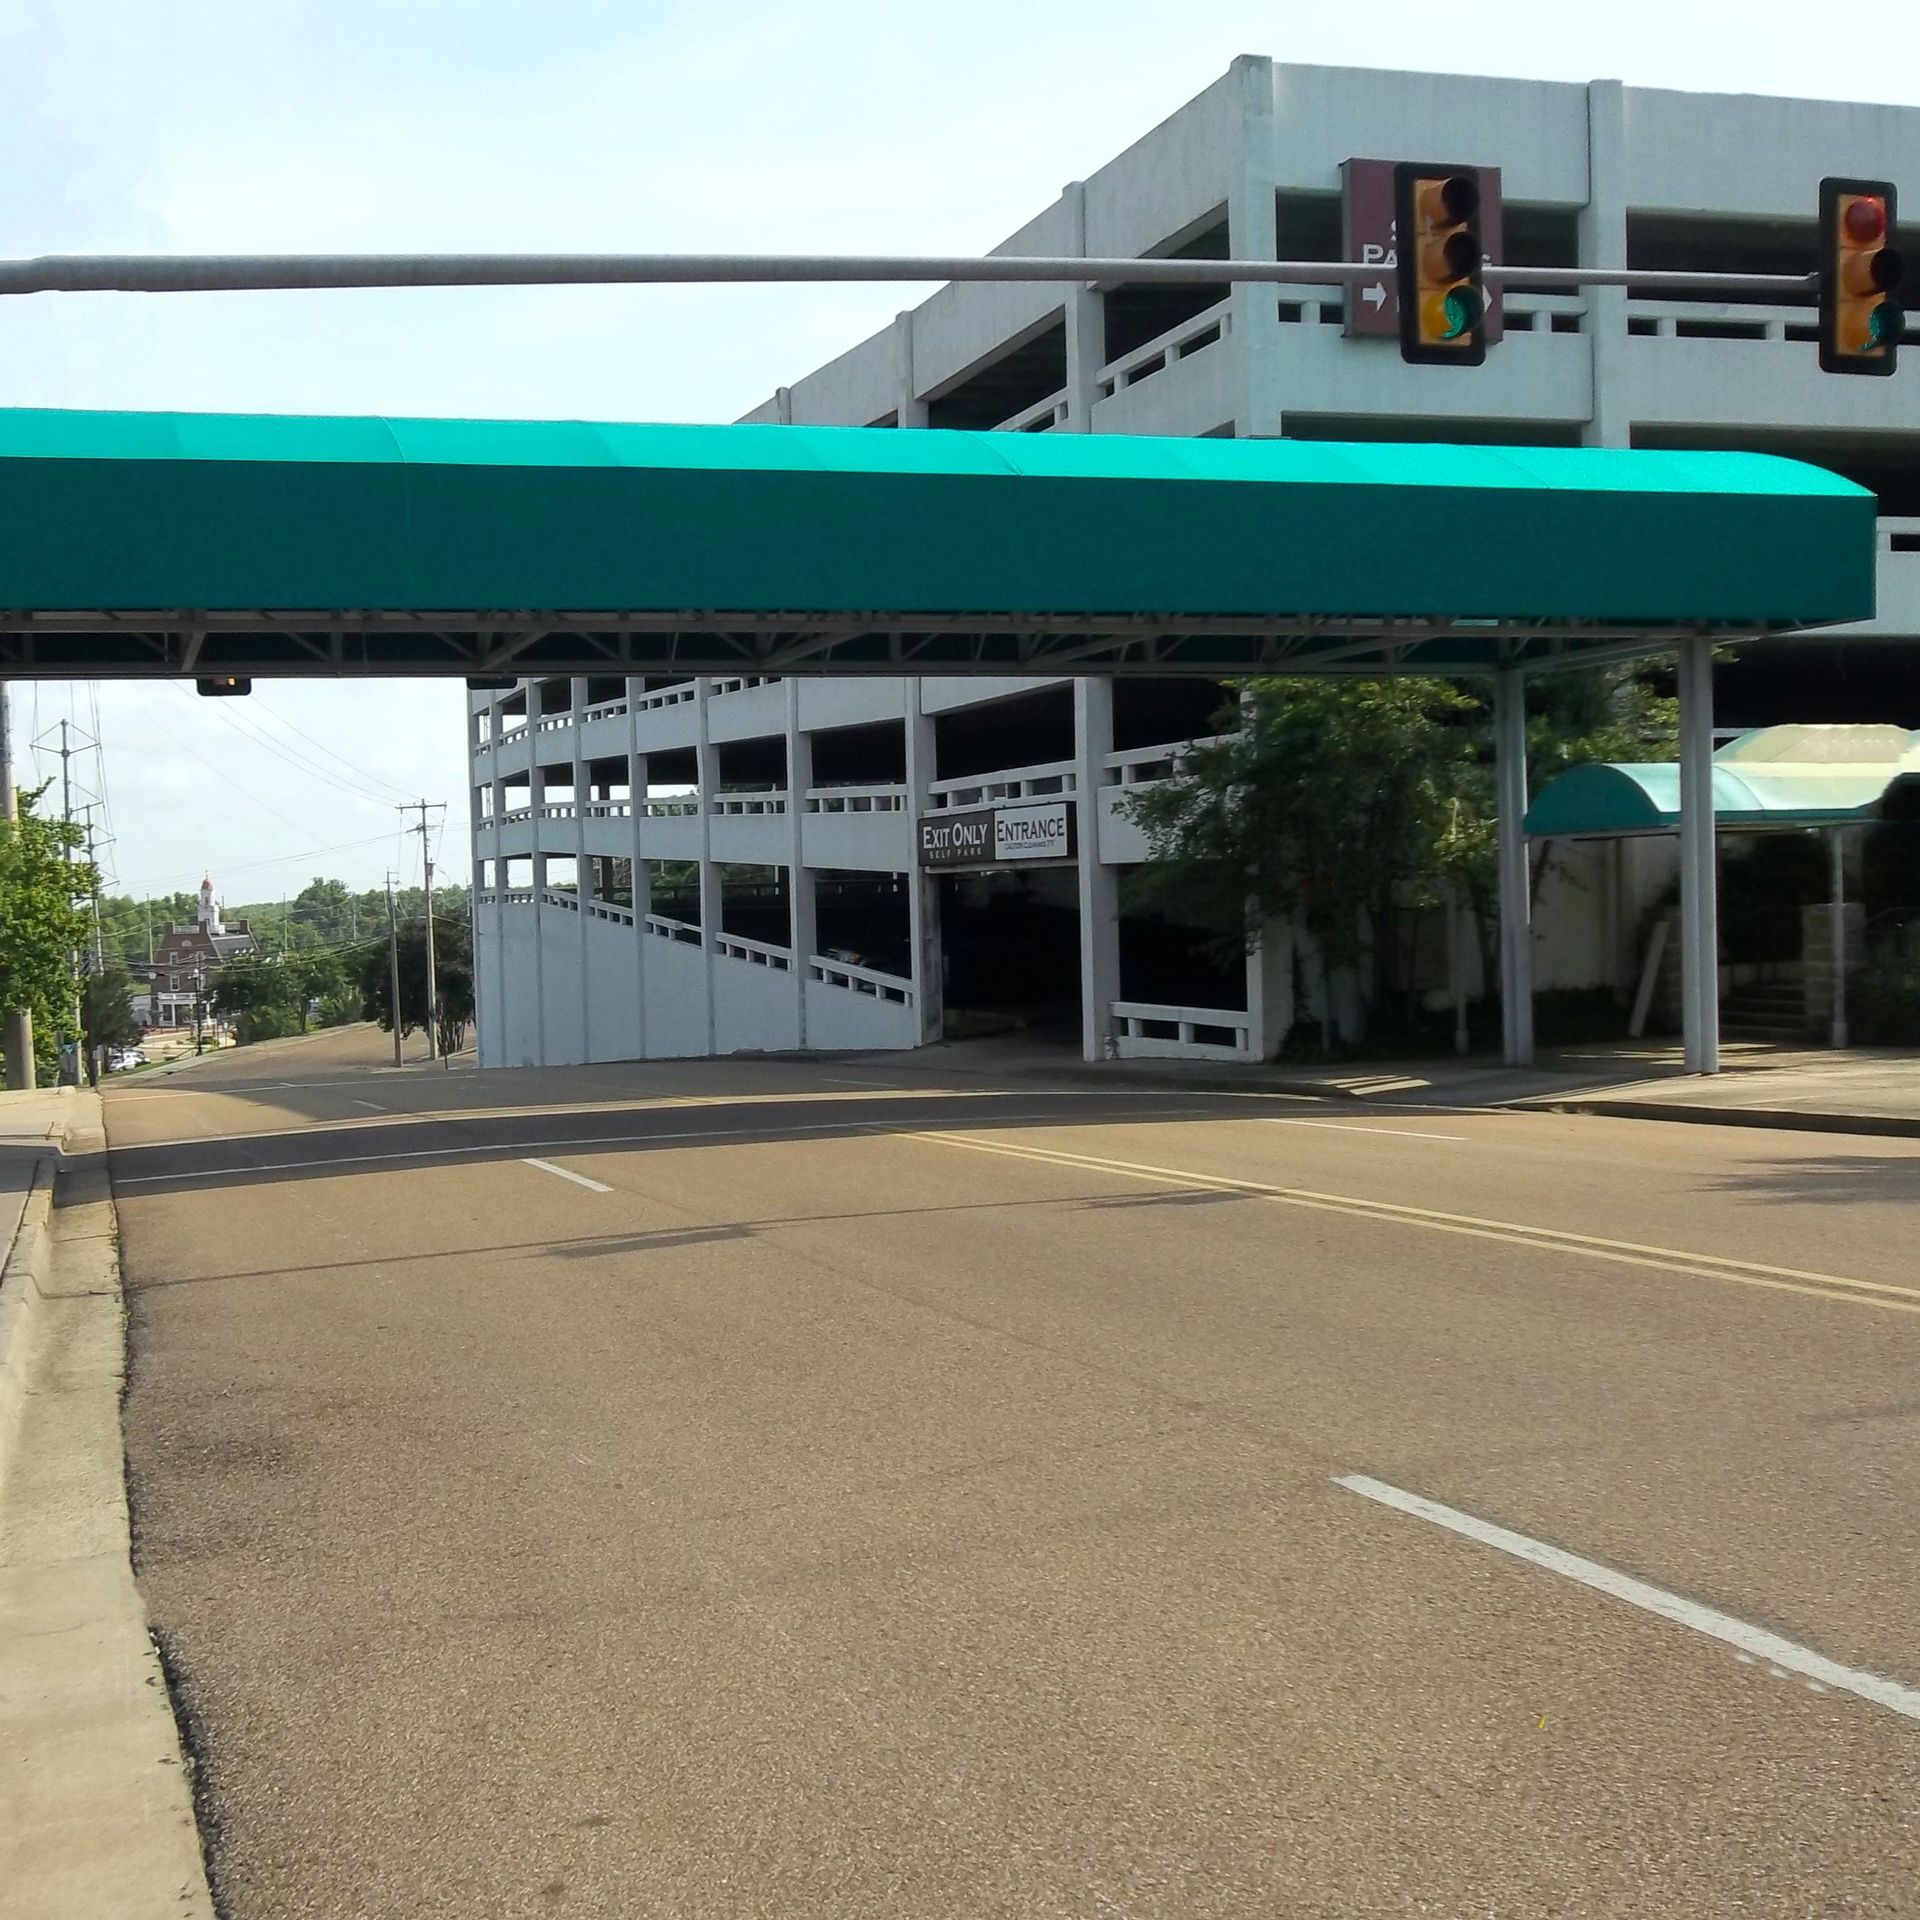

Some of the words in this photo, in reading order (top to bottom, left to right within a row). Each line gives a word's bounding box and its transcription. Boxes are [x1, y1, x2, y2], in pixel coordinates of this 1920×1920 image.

[923, 826, 950, 849] EXIT
[952, 823, 988, 846] ONLY
[997, 817, 1065, 842] ENTRANCE
[929, 849, 951, 859] SELF
[957, 847, 982, 857] PARK
